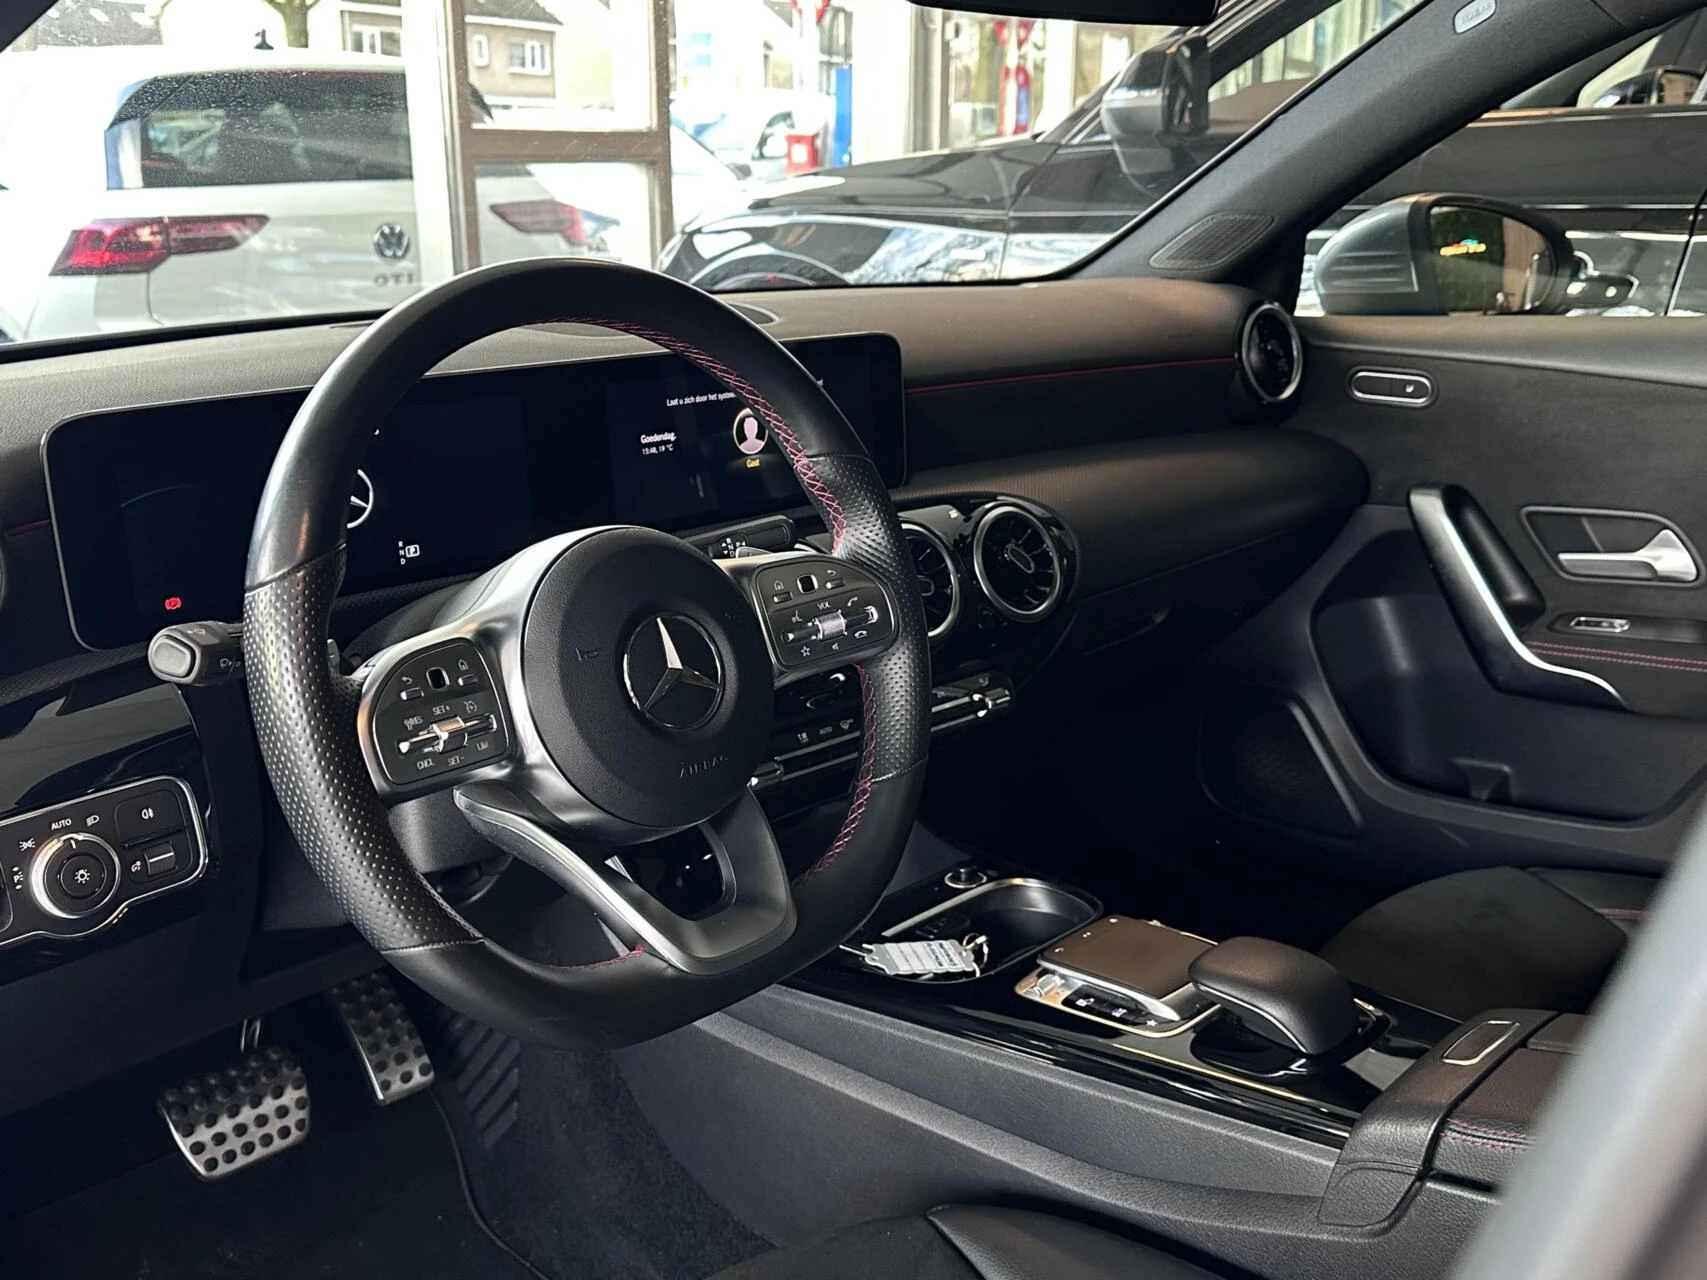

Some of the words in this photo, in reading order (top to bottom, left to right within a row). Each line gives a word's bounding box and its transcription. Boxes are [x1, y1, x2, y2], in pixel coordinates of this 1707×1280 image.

[666, 398, 679, 407] Laat
[684, 396, 695, 404] zich
[695, 395, 707, 403] door
[708, 393, 717, 401] het
[51, 818, 72, 831] AUTO
